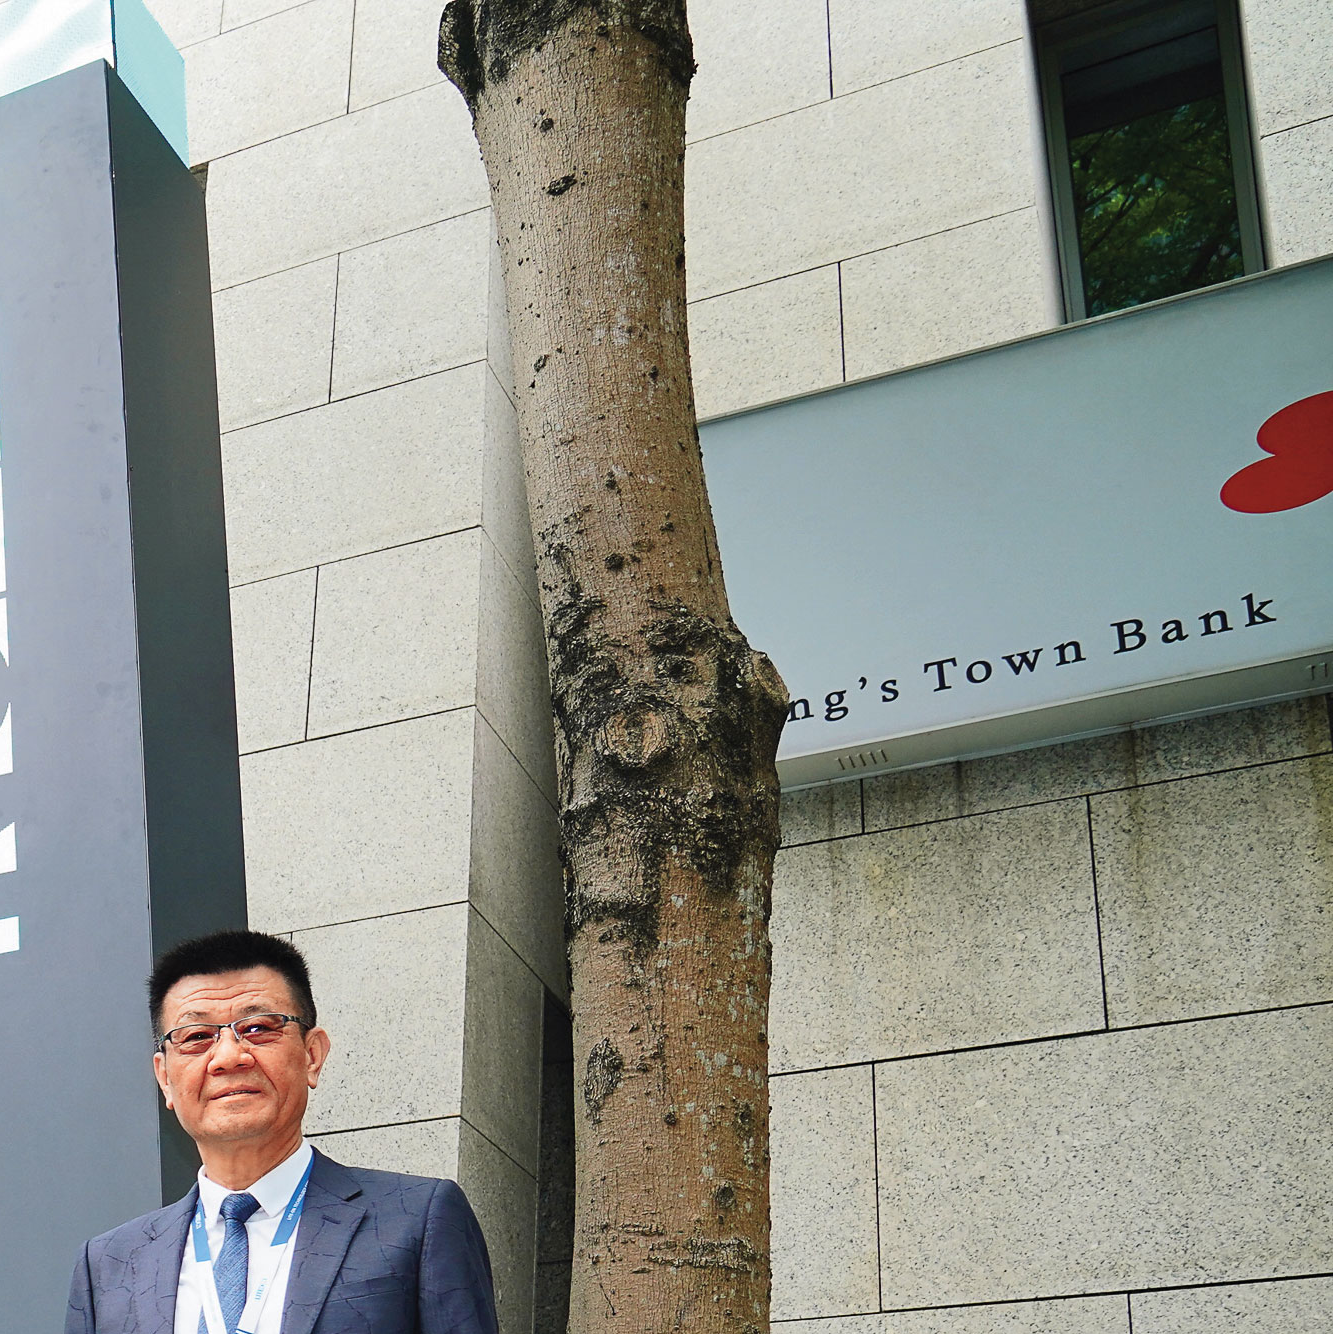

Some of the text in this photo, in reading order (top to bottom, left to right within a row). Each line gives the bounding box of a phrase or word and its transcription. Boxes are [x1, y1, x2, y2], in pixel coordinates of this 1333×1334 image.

[787, 593, 1277, 722] ng's Town Bank
